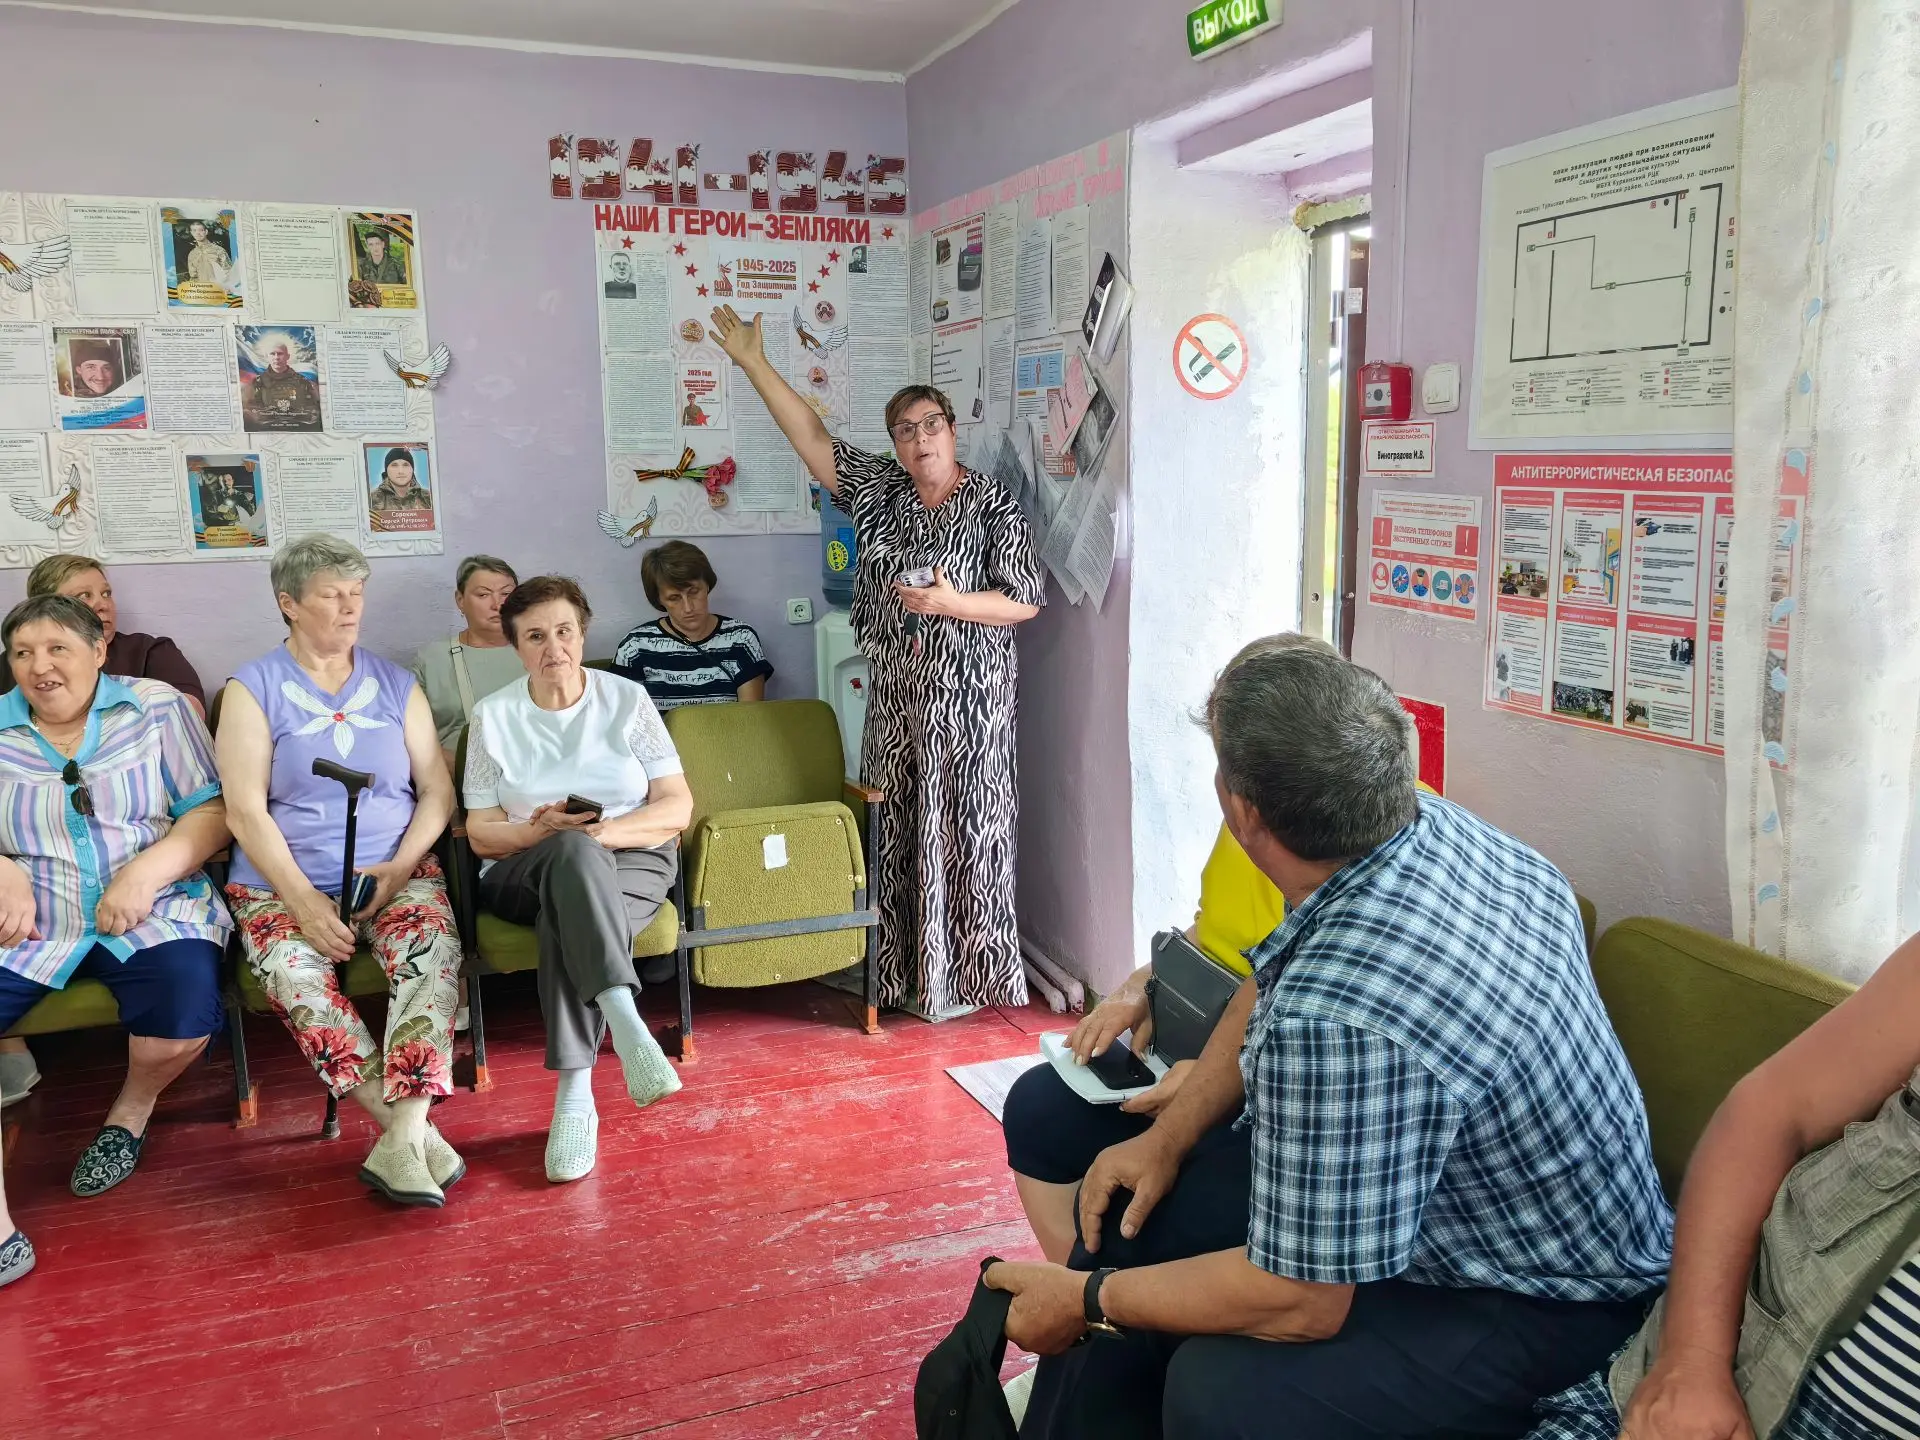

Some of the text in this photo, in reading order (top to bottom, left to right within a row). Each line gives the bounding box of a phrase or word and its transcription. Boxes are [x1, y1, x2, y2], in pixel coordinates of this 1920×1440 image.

[1193, 0, 1260, 44] ВЫХОД
[1609, 151, 1634, 163] людей
[1635, 147, 1650, 158] при
[1651, 132, 1716, 152] возникновении
[1588, 165, 1613, 178] других
[1614, 151, 1671, 171] чрезвычайных
[1672, 141, 1712, 158] ситуаций
[548, 132, 907, 215] 1941-1945
[594, 204, 659, 233] НАШИ
[736, 258, 797, 274] 1945-2025
[737, 279, 750, 290] Год
[737, 290, 783, 300] Отечества
[1377, 450, 1412, 461] Виноградова
[1063, 461, 1075, 472] 112
[1511, 466, 1663, 482] АНТИТЕРРОРИСТИЧЕСКАЯ
